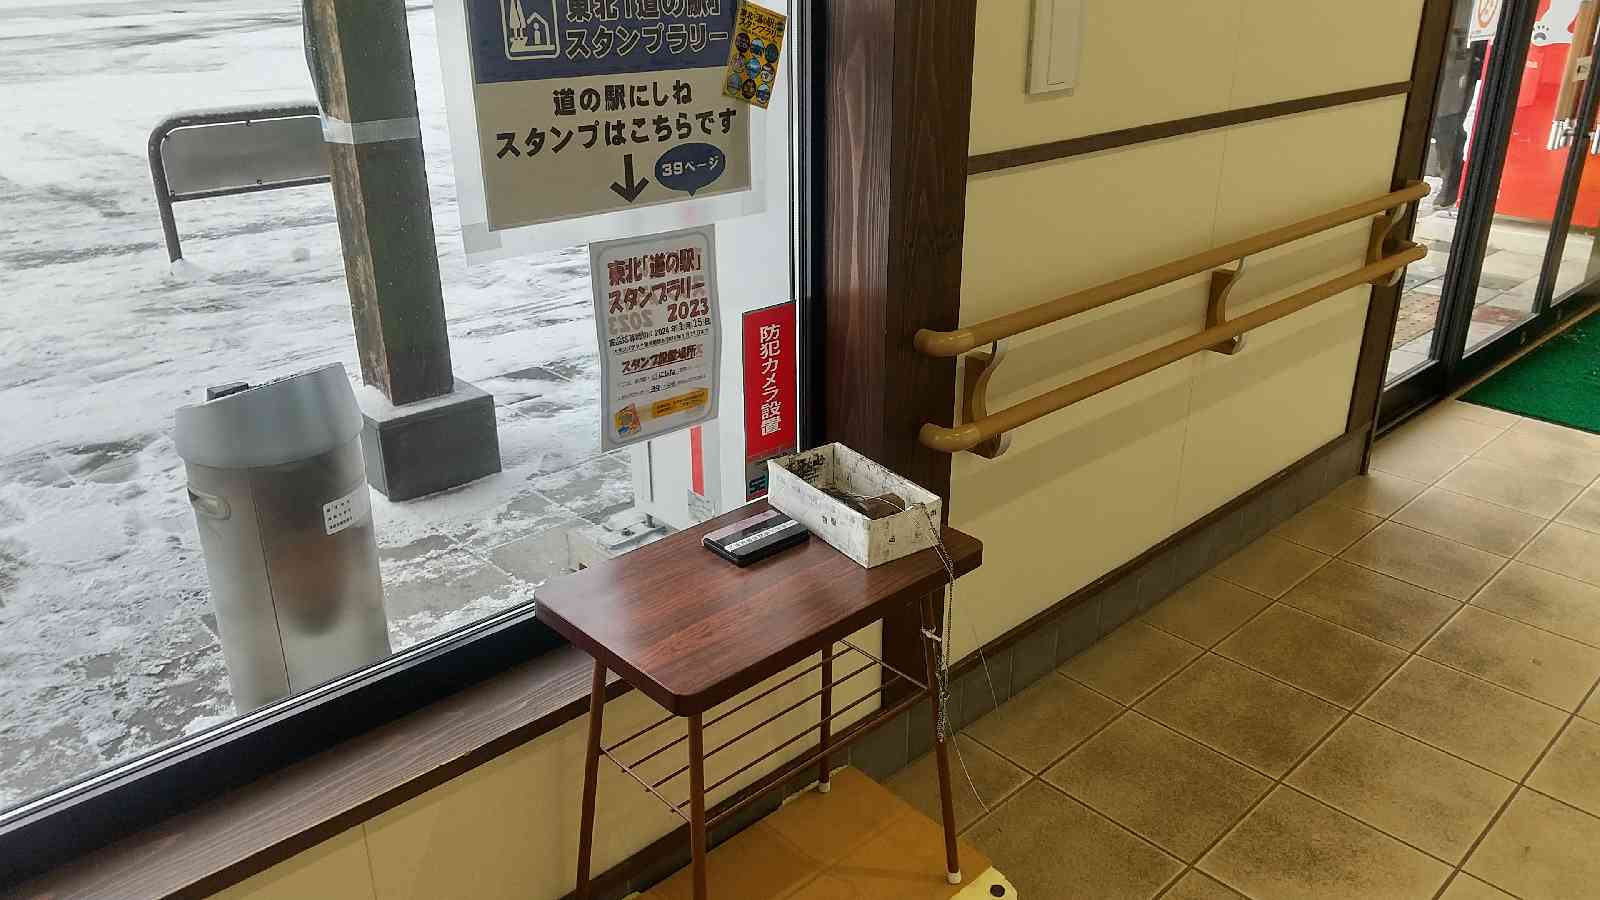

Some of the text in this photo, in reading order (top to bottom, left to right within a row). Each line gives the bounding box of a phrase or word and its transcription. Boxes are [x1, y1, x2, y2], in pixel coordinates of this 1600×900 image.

[565, 23, 729, 60] スタンプラリー
[552, 80, 692, 117] 道の駅にしね
[496, 108, 737, 159] スタンプはこちらです
[661, 155, 720, 177] 39ページ
[607, 248, 703, 286] 東北「道の駅」
[608, 275, 705, 314] スタンプラリー
[667, 298, 710, 322] 2023
[759, 324, 781, 436] 防犯カメラ設置
